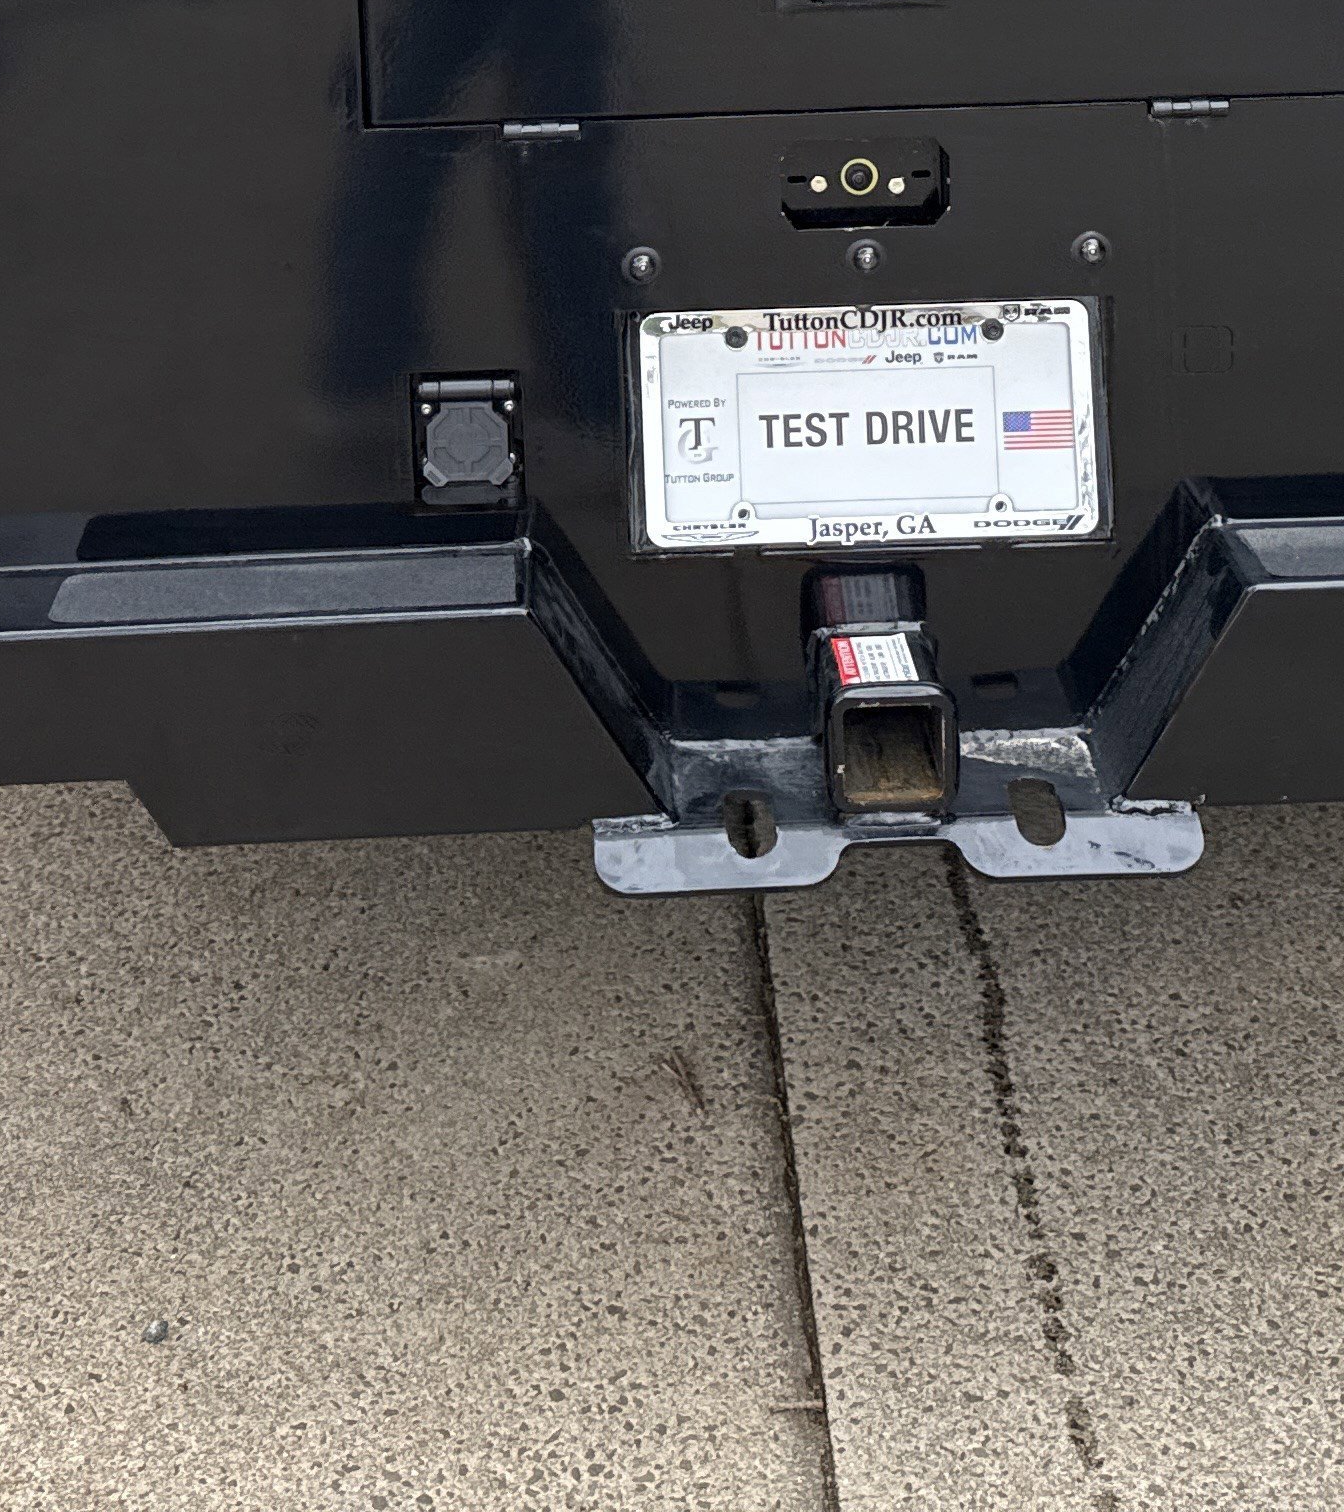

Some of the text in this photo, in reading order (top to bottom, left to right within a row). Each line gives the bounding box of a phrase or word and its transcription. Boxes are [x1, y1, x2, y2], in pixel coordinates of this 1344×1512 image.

[669, 315, 713, 330] Jeep
[763, 309, 962, 333] TuttonCDJR.com
[885, 350, 922, 365] Jeep
[758, 408, 975, 448] TEST DRIVE
[673, 523, 746, 531] CHRYSLER
[809, 515, 937, 542] Jasper, GA
[973, 518, 1067, 528] DODGE
